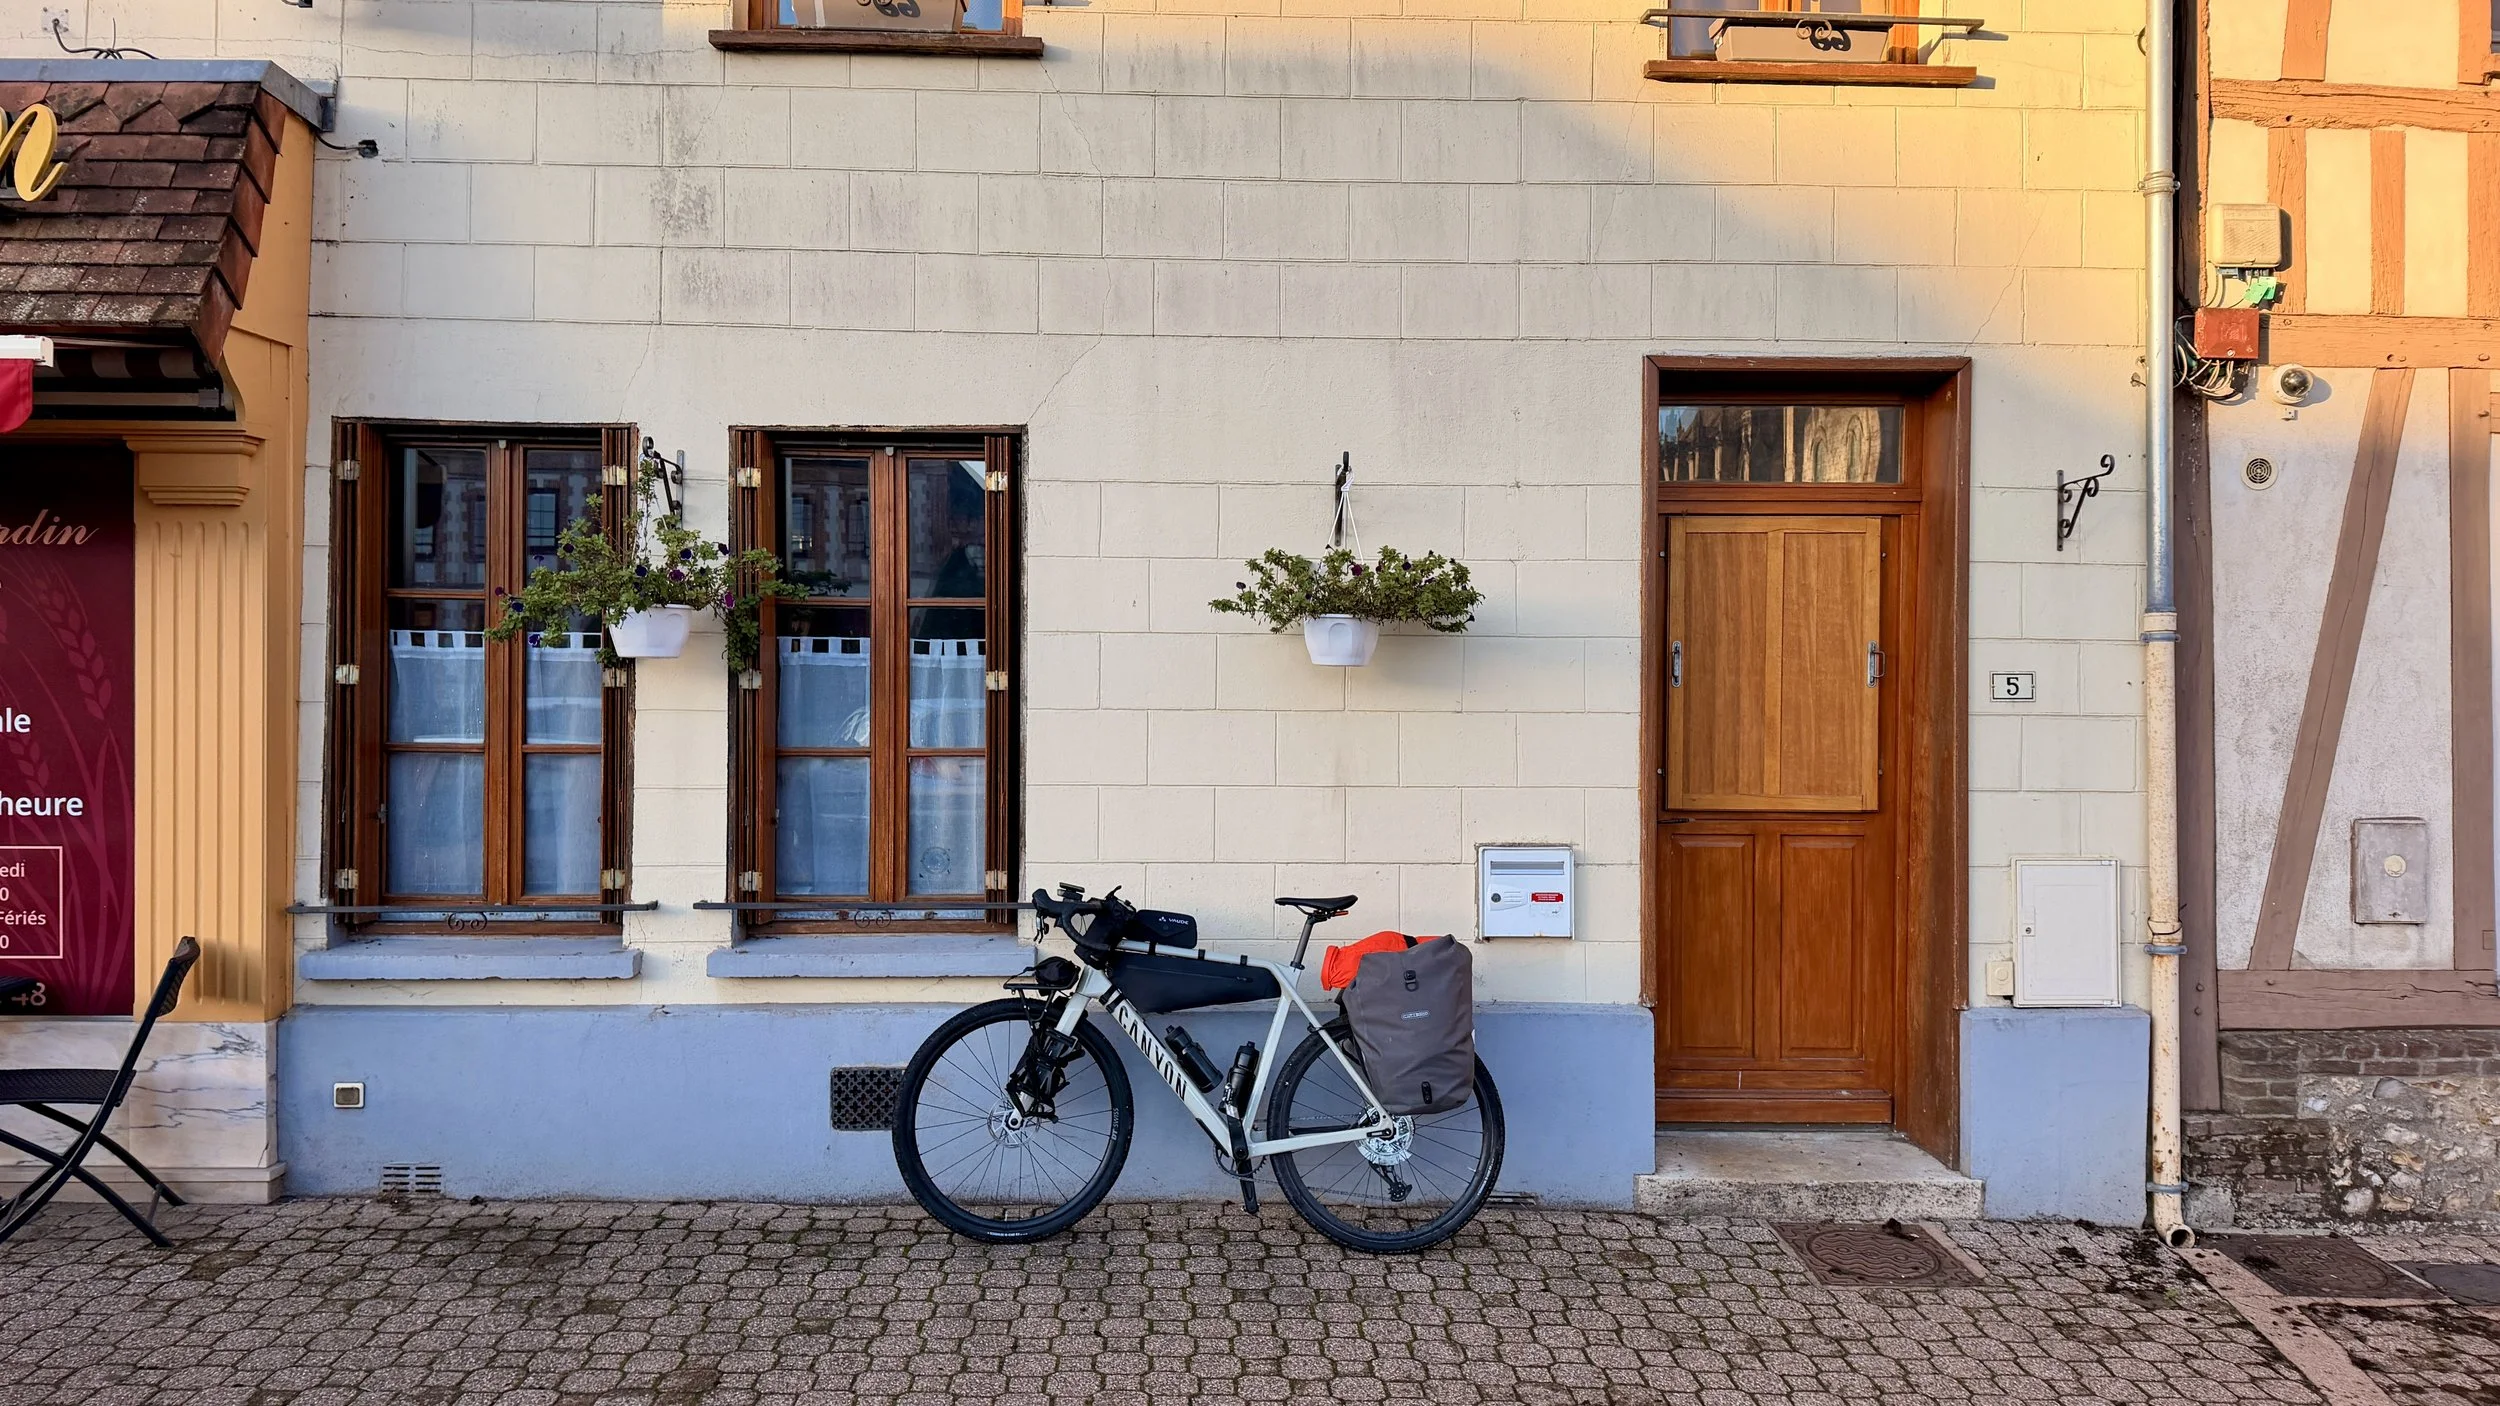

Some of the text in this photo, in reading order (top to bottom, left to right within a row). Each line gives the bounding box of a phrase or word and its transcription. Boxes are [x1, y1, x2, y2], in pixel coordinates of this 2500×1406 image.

[2006, 676, 2020, 696] 5
[0, 707, 31, 733] le
[0, 790, 84, 816] heure
[1118, 1005, 1187, 1101] CANYON
